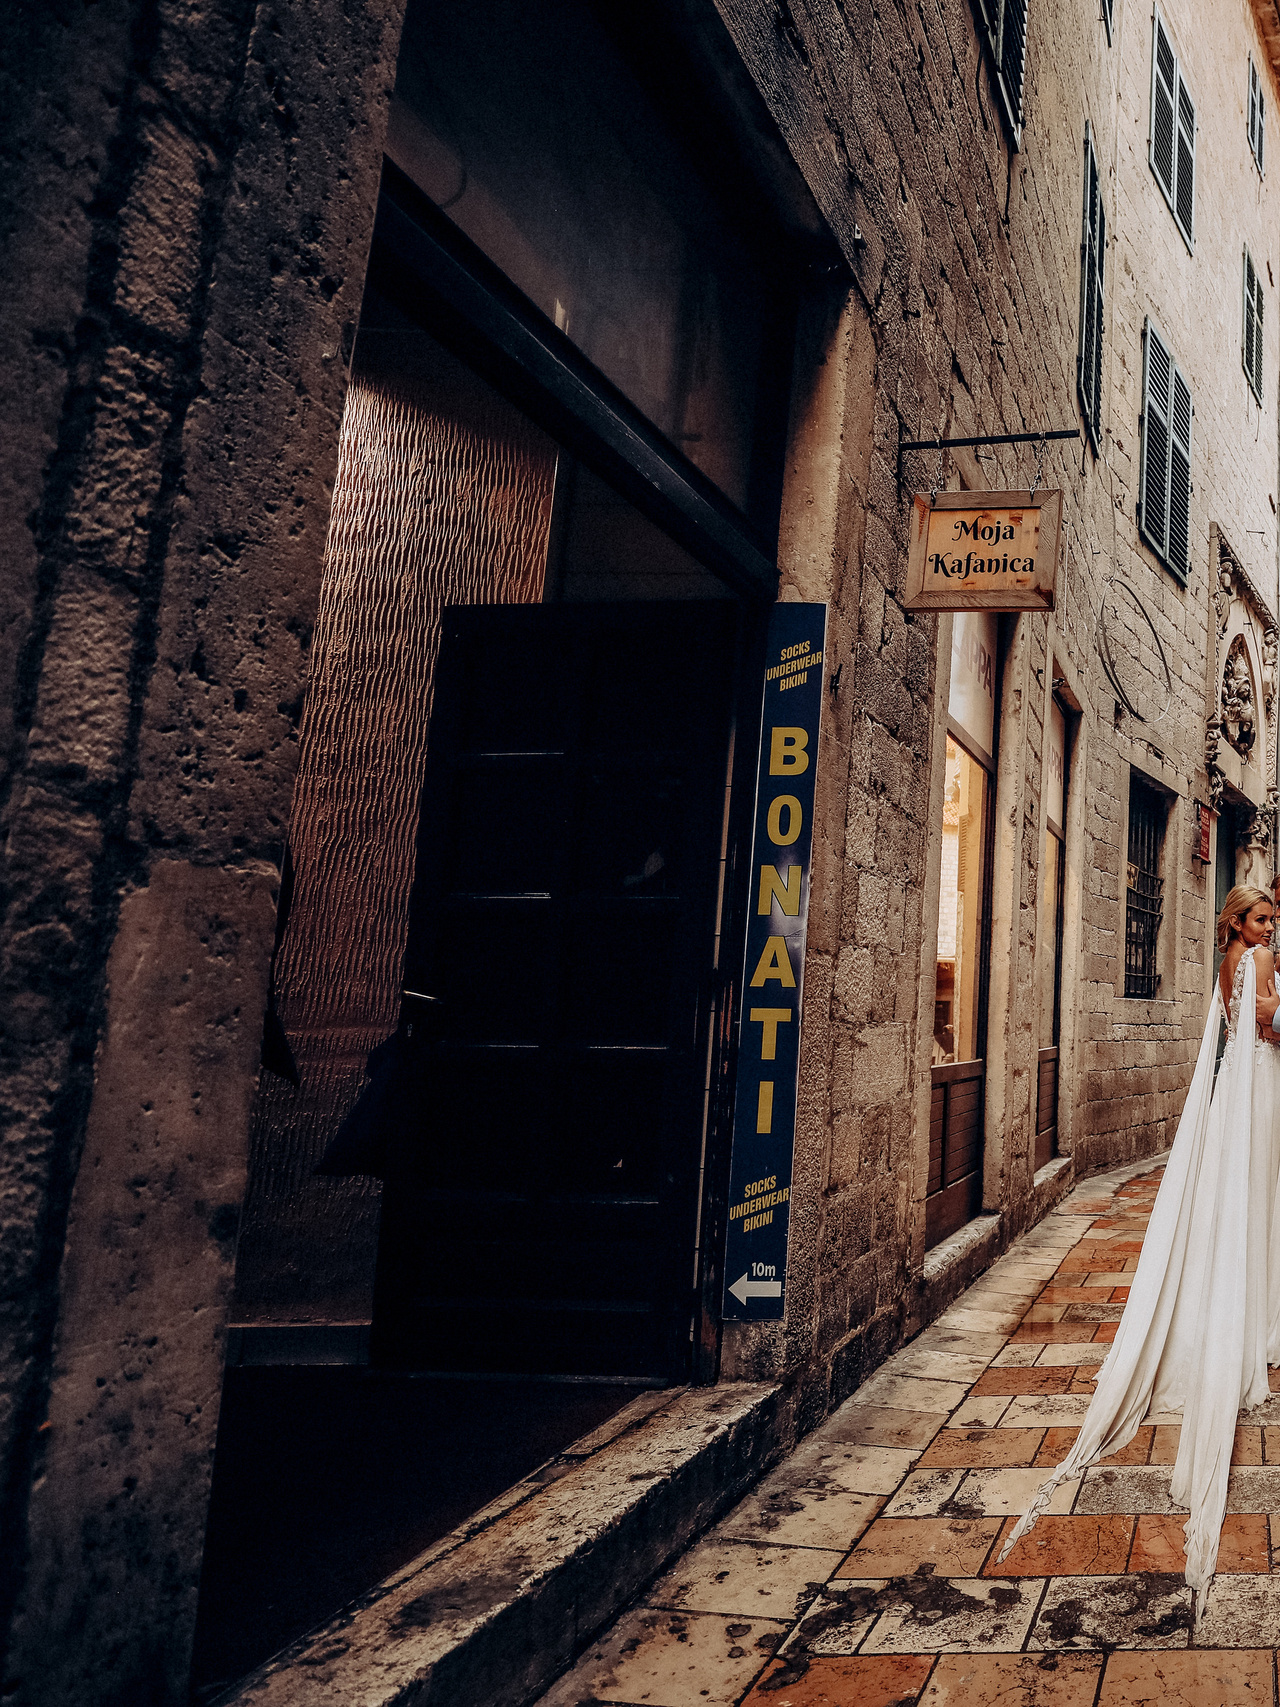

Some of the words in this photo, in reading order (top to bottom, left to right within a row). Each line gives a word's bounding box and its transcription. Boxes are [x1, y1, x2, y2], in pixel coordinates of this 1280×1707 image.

[952, 516, 1015, 546] Moja
[928, 552, 1035, 580] Kafanica
[780, 640, 811, 661] SOCKS
[766, 651, 823, 681] UNDERWEAR
[779, 671, 808, 692] BIKINI
[749, 726, 810, 1134] BONATI
[744, 1175, 776, 1198] SOCKS
[729, 1187, 789, 1221] UNDERWEAR
[743, 1210, 773, 1233] BIKINI
[751, 1262, 776, 1277] 10m
